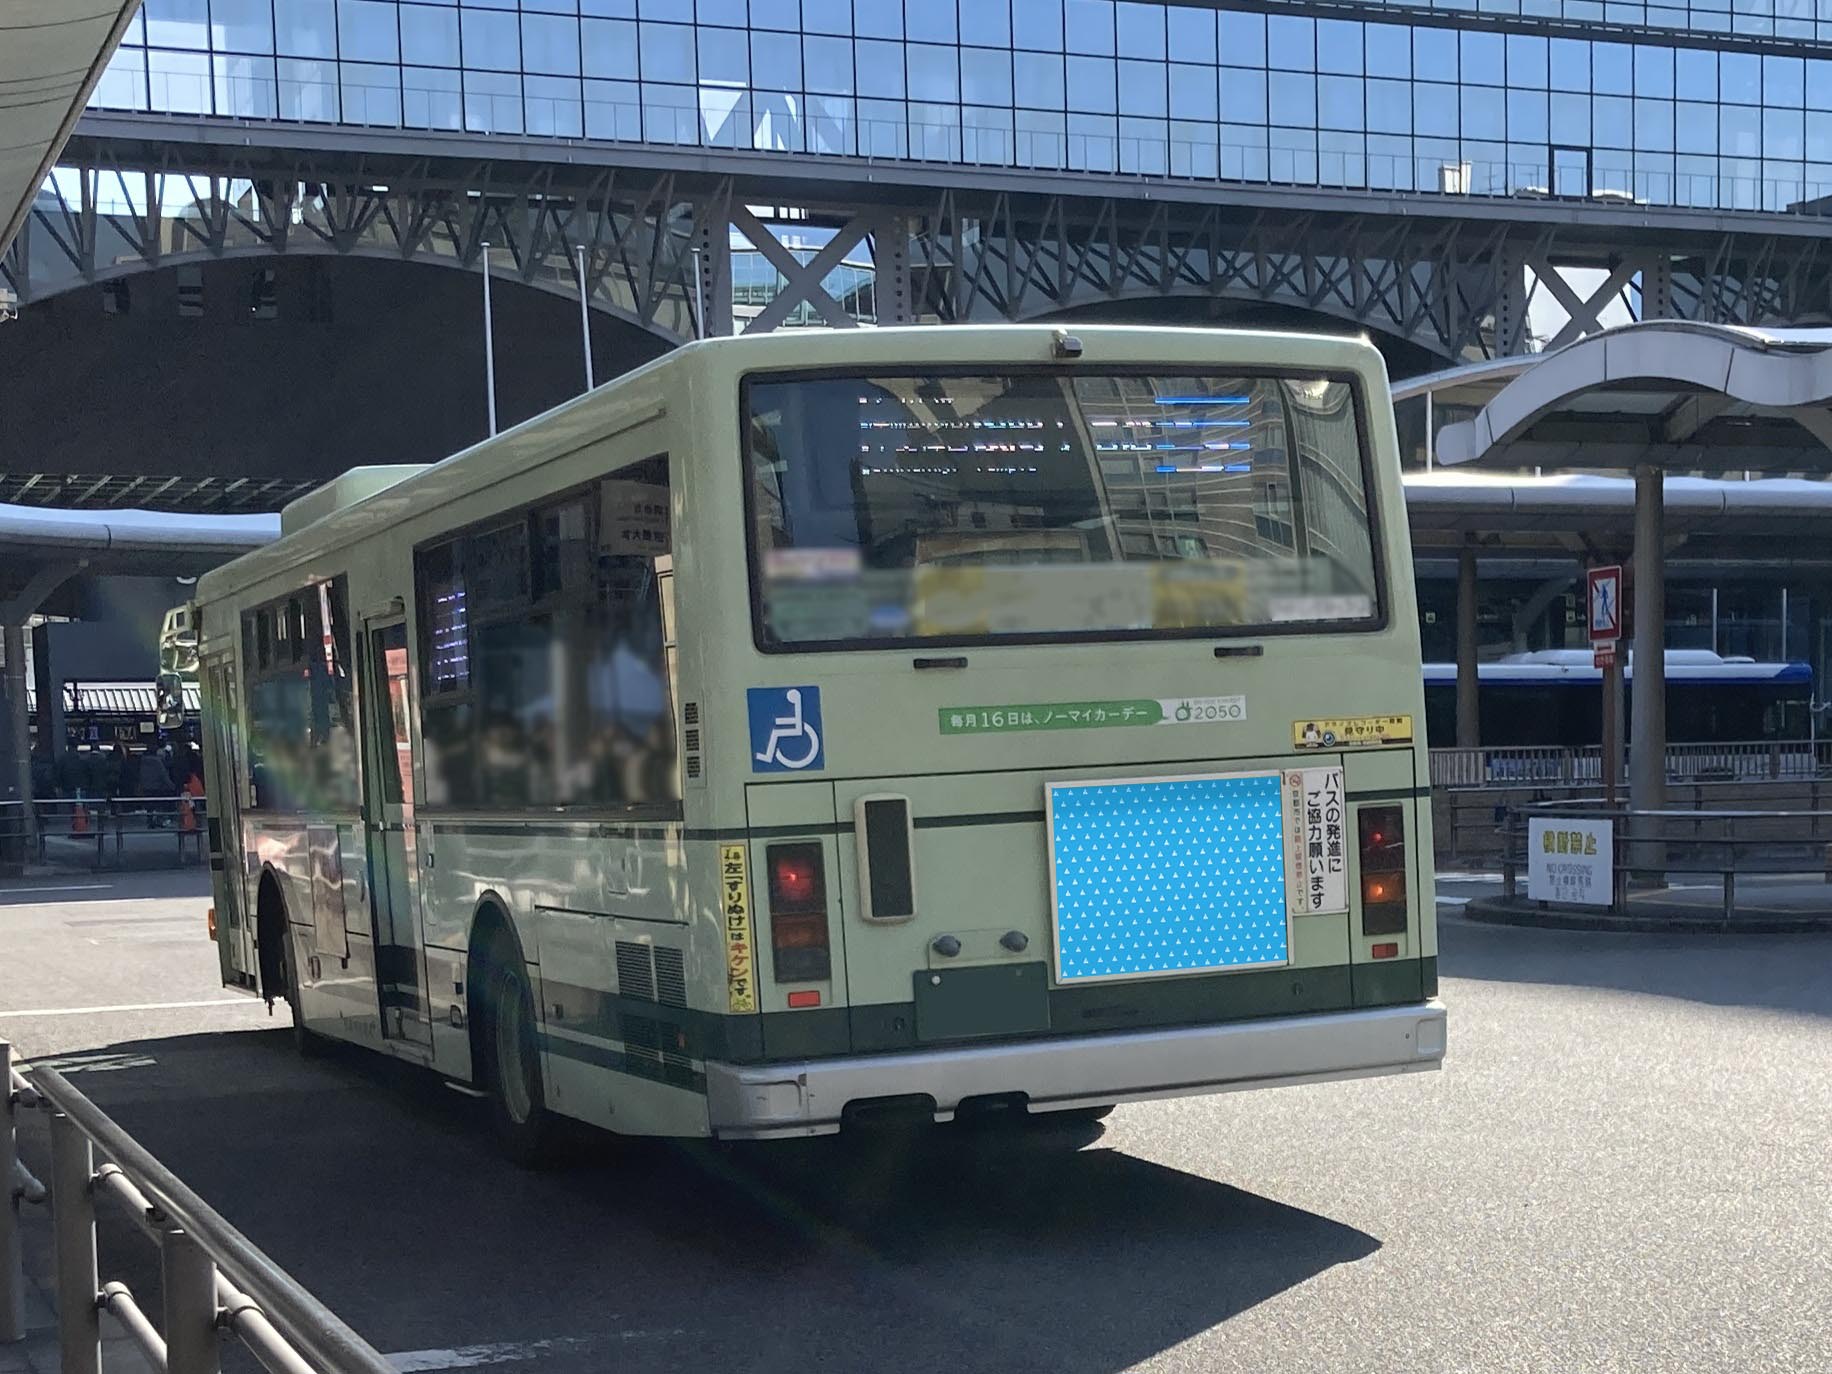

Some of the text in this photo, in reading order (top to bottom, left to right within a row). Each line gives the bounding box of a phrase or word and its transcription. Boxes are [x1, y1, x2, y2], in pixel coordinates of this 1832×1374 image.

[950, 706, 1149, 728] 毎月16日は、ノーマイカーデー
[1194, 704, 1241, 720] 2050
[1307, 790, 1325, 909] ご協力願います
[1324, 772, 1342, 874] バスの発進に
[724, 862, 749, 996] 左「すりぬけ」はキケンです
